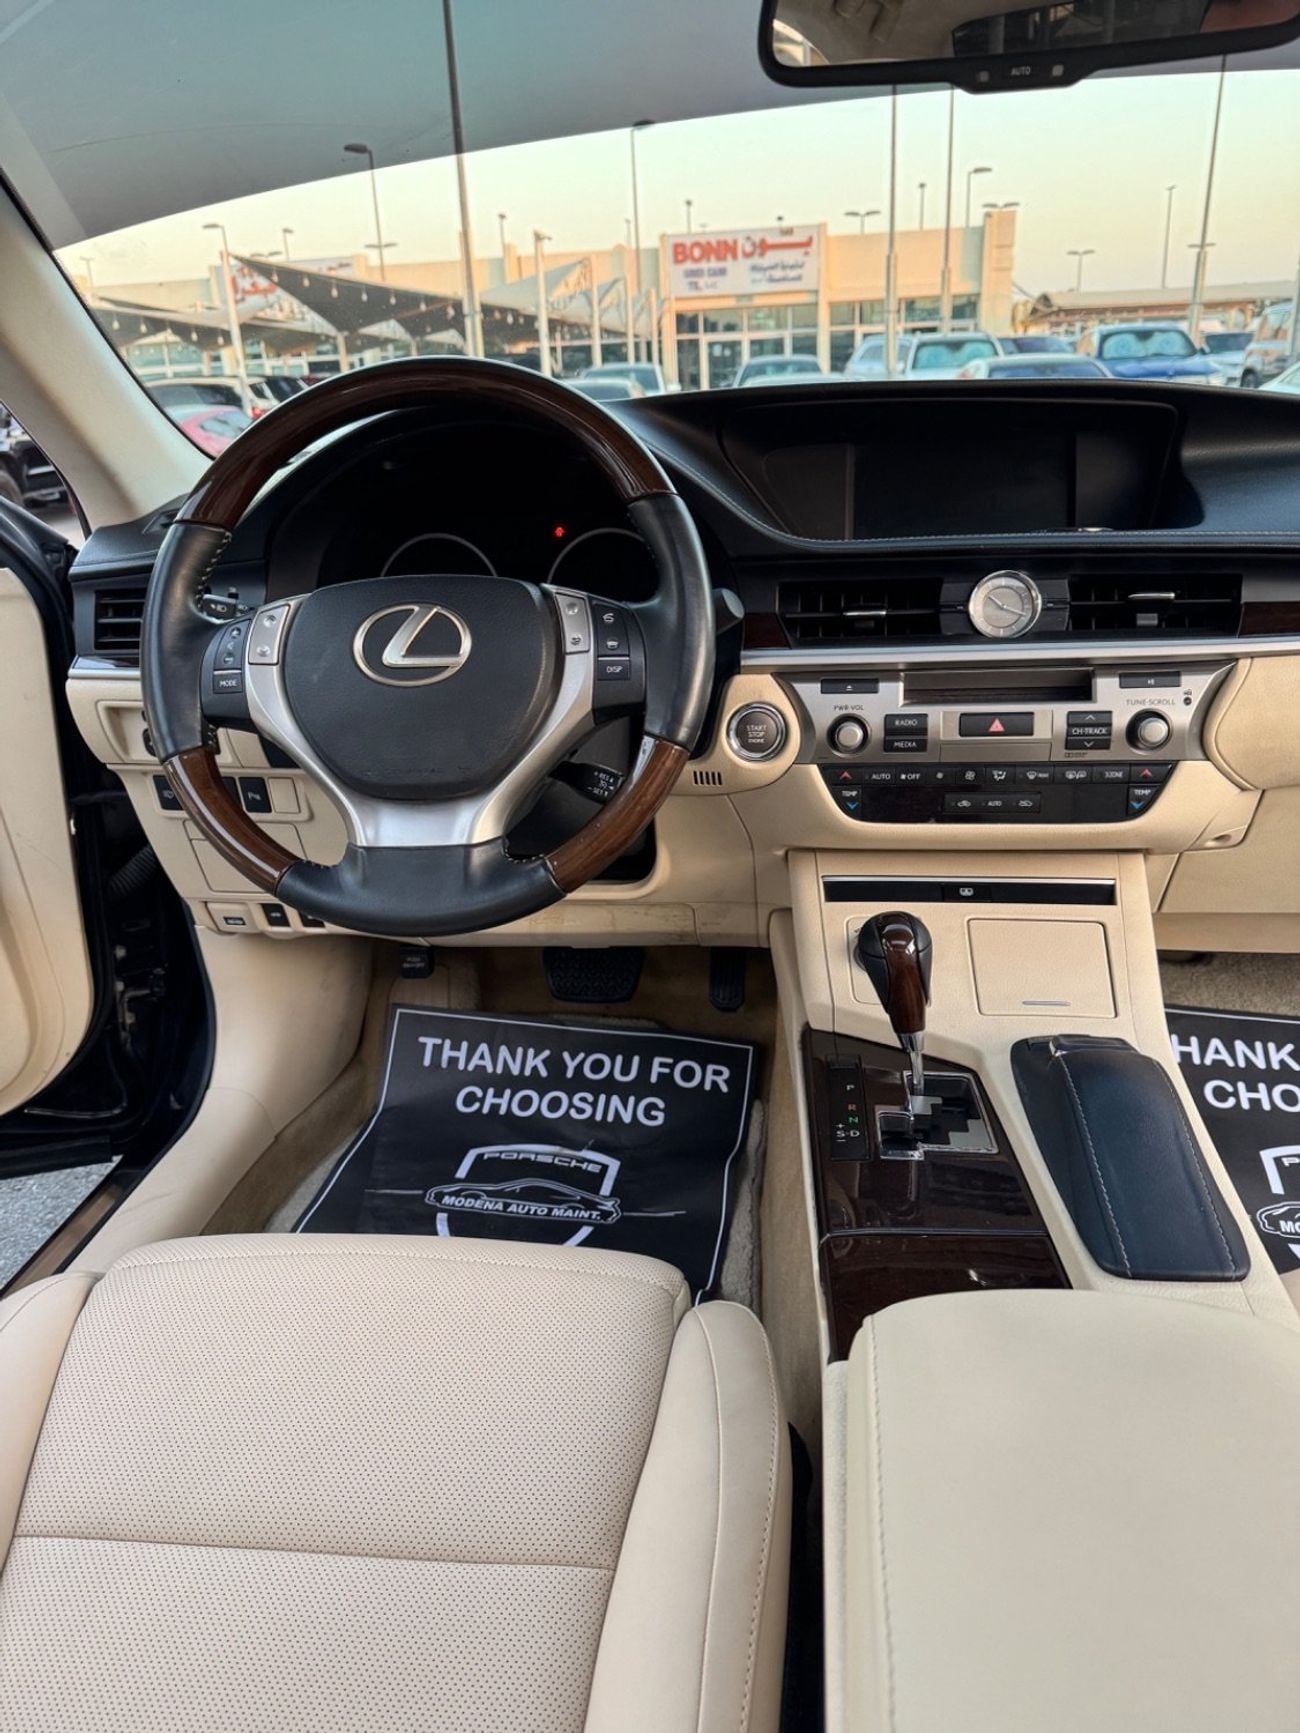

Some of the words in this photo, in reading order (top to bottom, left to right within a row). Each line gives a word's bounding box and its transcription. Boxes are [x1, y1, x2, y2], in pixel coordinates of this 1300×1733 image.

[1010, 65, 1031, 76] AUTO
[672, 238, 738, 265] BONN
[606, 665, 623, 674] DISP
[219, 680, 237, 688] MODE
[894, 719, 918, 727] RADIO
[893, 741, 917, 749] MEDIA
[871, 773, 891, 781] AUTO
[907, 773, 920, 781] OFF
[841, 790, 858, 798] TEMP
[1134, 788, 1151, 796] TEMP
[418, 1036, 551, 1079] THANK
[562, 1050, 640, 1083] YOU
[650, 1056, 731, 1094] FOR
[455, 1085, 666, 1127] CHOOSING
[482, 1151, 603, 1173] PORSCHE
[441, 1195, 504, 1211] MODENA
[507, 1203, 548, 1216] AUTO
[551, 1208, 601, 1220] MAINT.
